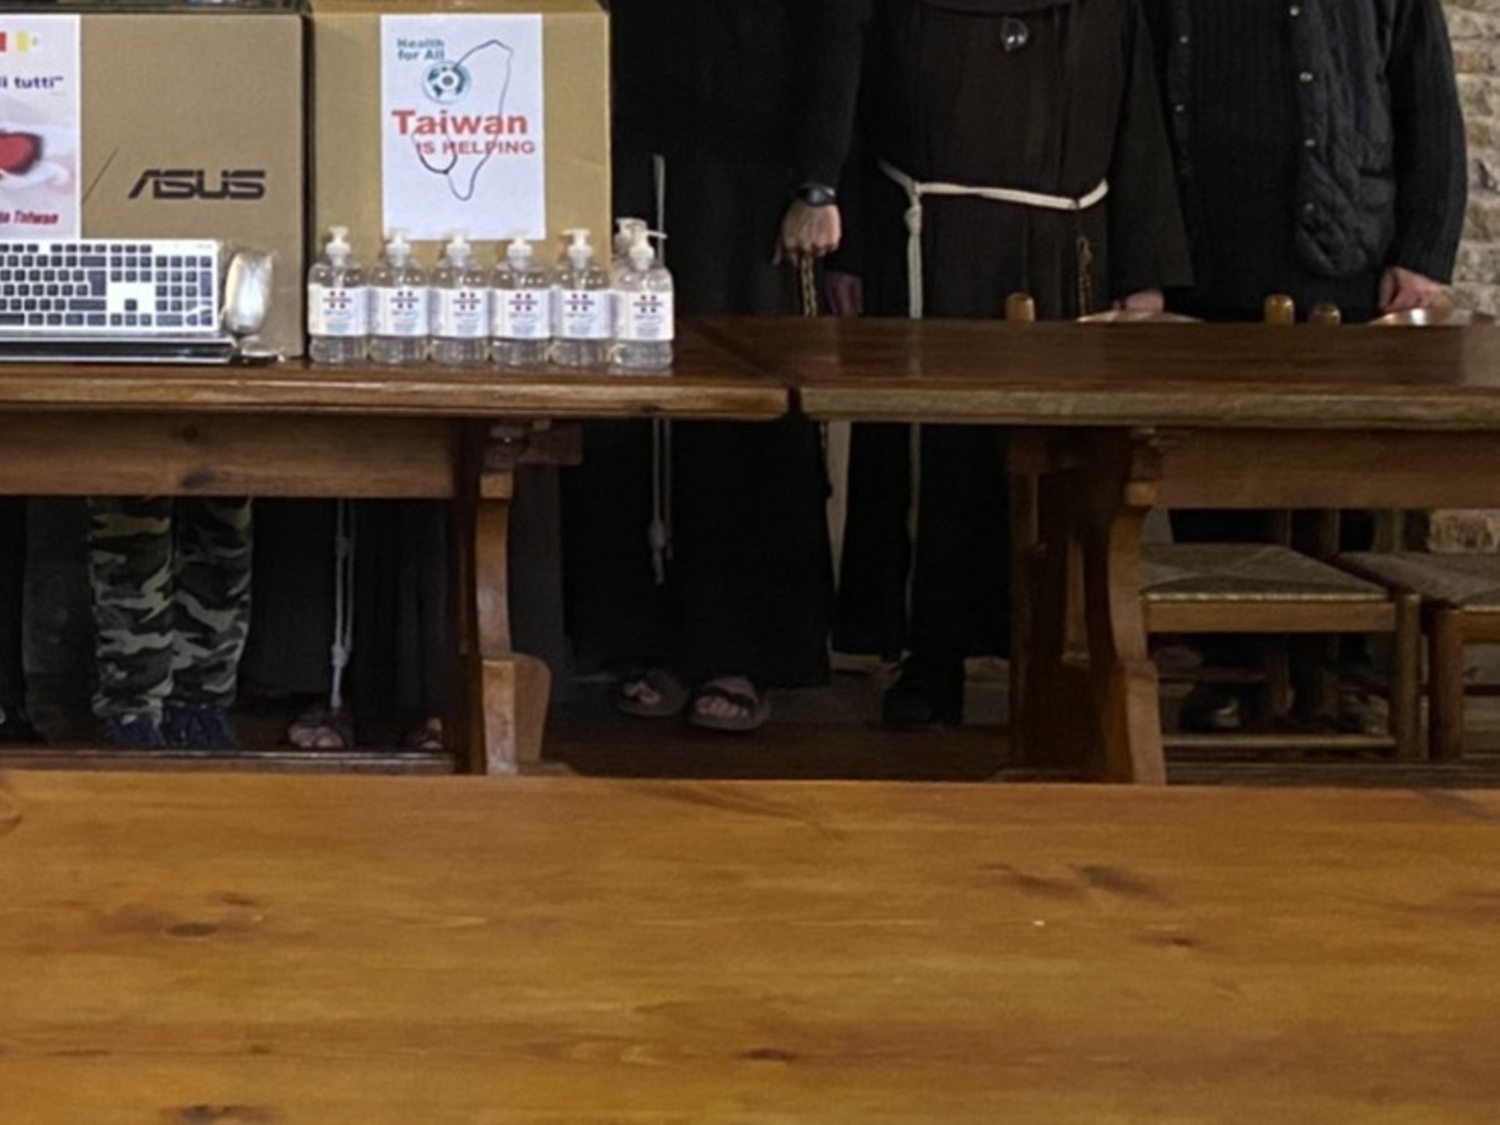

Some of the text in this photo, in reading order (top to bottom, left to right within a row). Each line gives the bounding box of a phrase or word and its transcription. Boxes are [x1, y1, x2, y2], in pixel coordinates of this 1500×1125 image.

[397, 38, 445, 49] Health
[398, 49, 445, 60] for All
[391, 109, 528, 135] Taiwan
[415, 140, 536, 155] IS HELPING
[127, 169, 266, 200] ASUS
